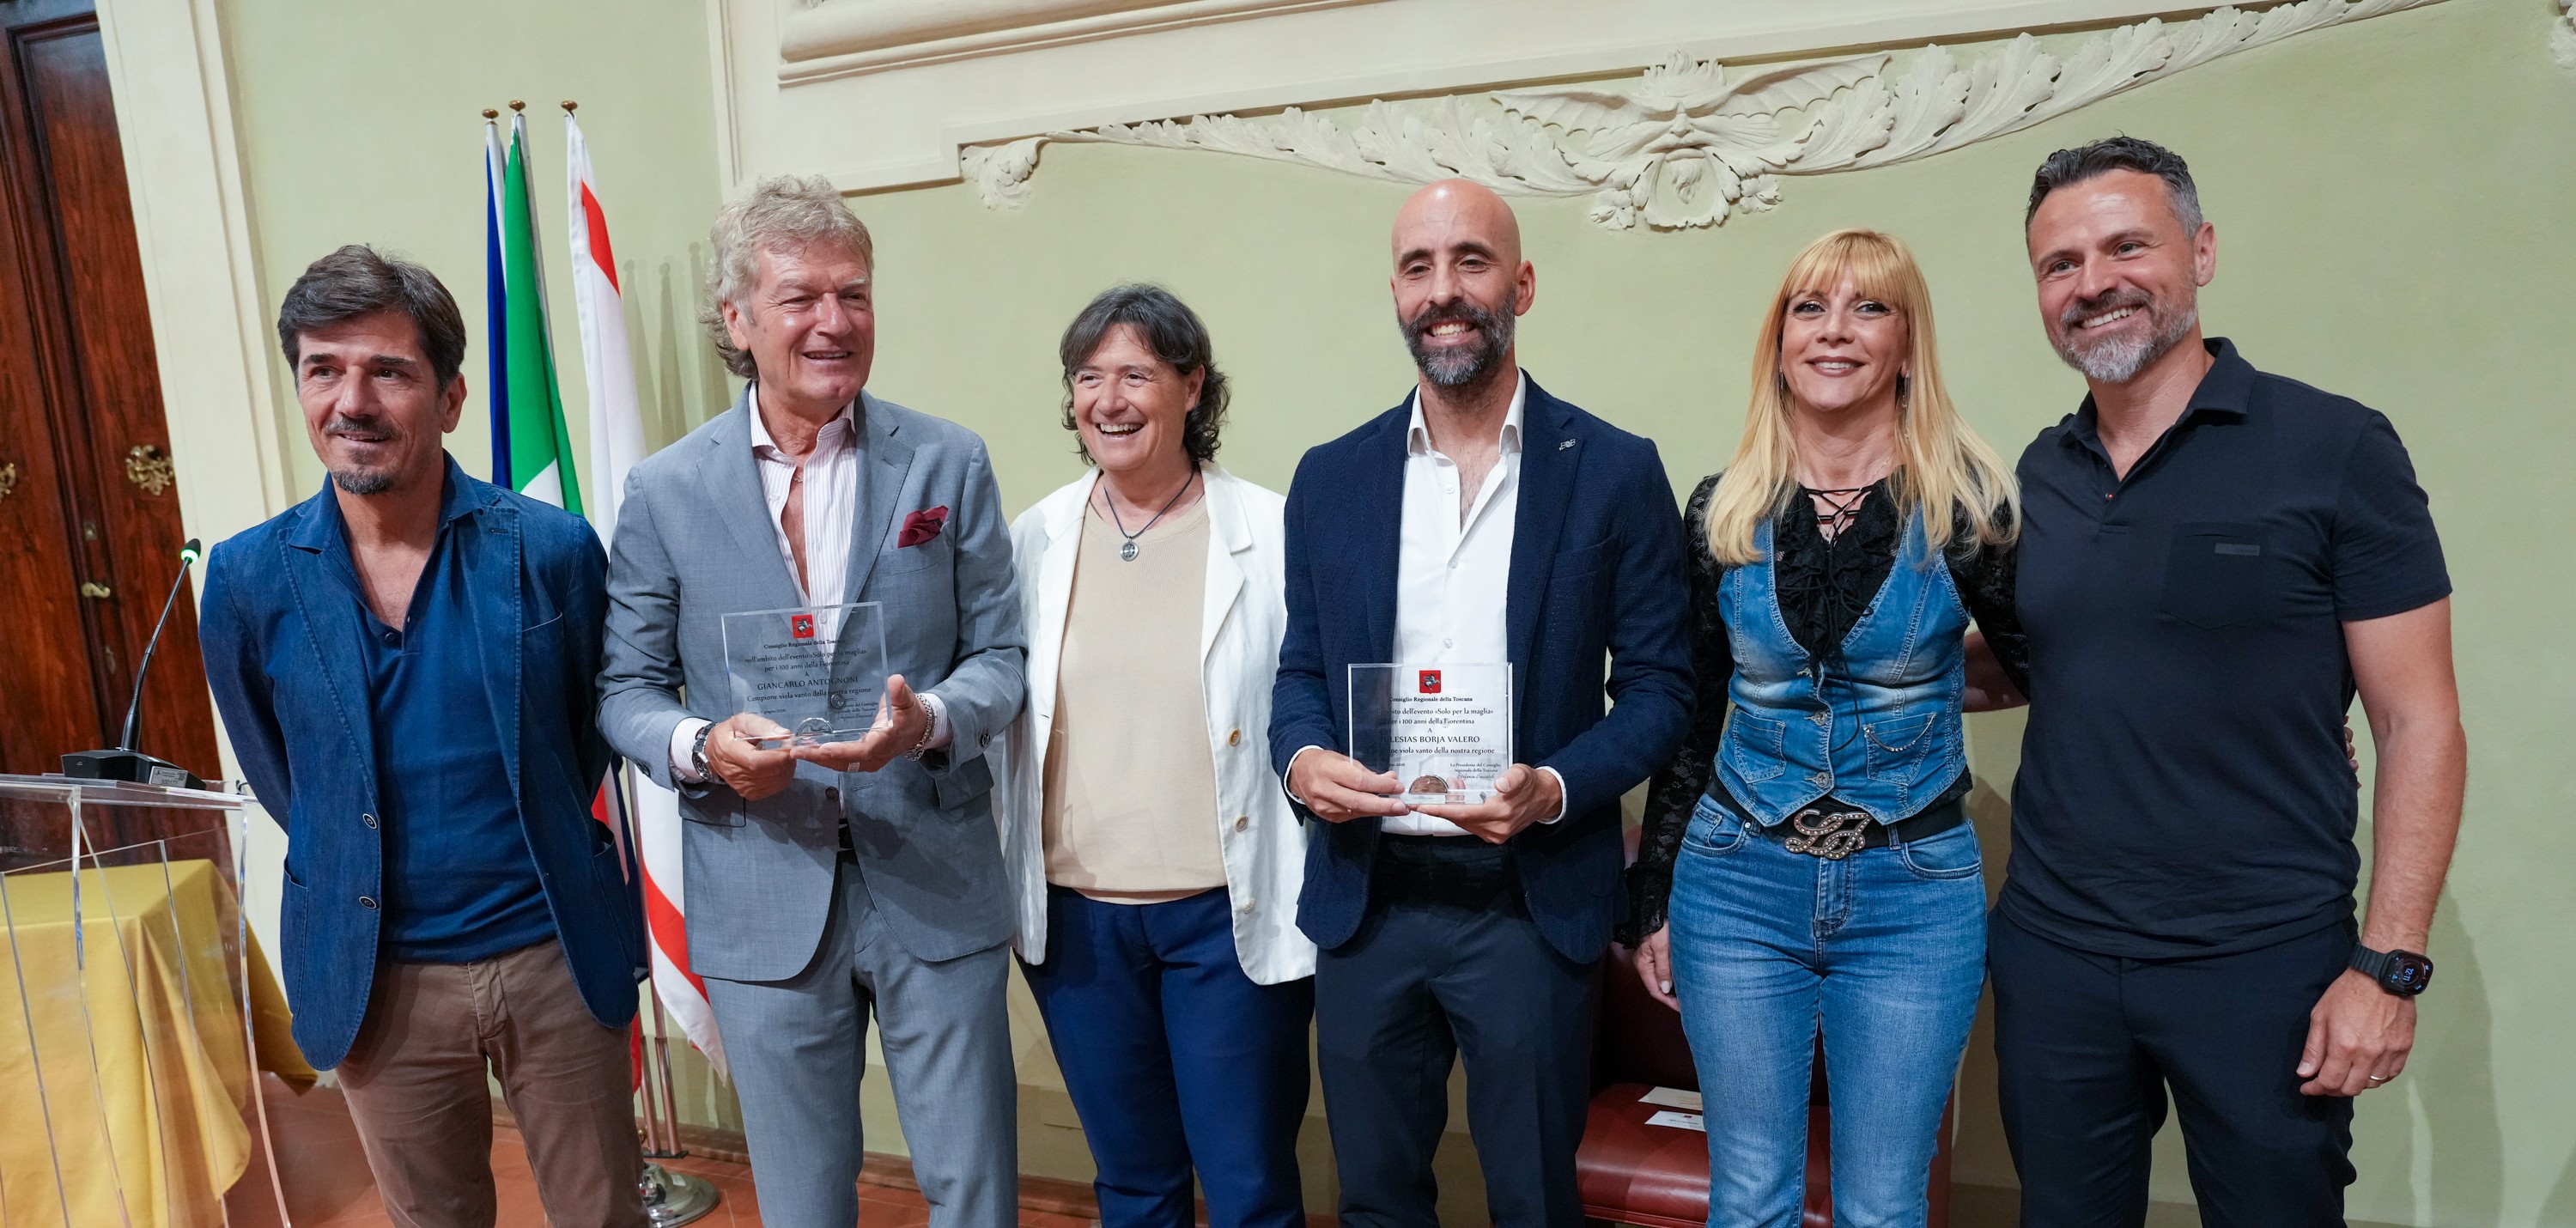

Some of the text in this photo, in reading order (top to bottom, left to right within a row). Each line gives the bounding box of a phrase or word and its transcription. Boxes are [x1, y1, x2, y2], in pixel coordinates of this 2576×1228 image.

[757, 676, 858, 690] GIANCARLO ANTOGNONI
[747, 695, 778, 703] Campione
[1471, 707, 1493, 716] maglia»
